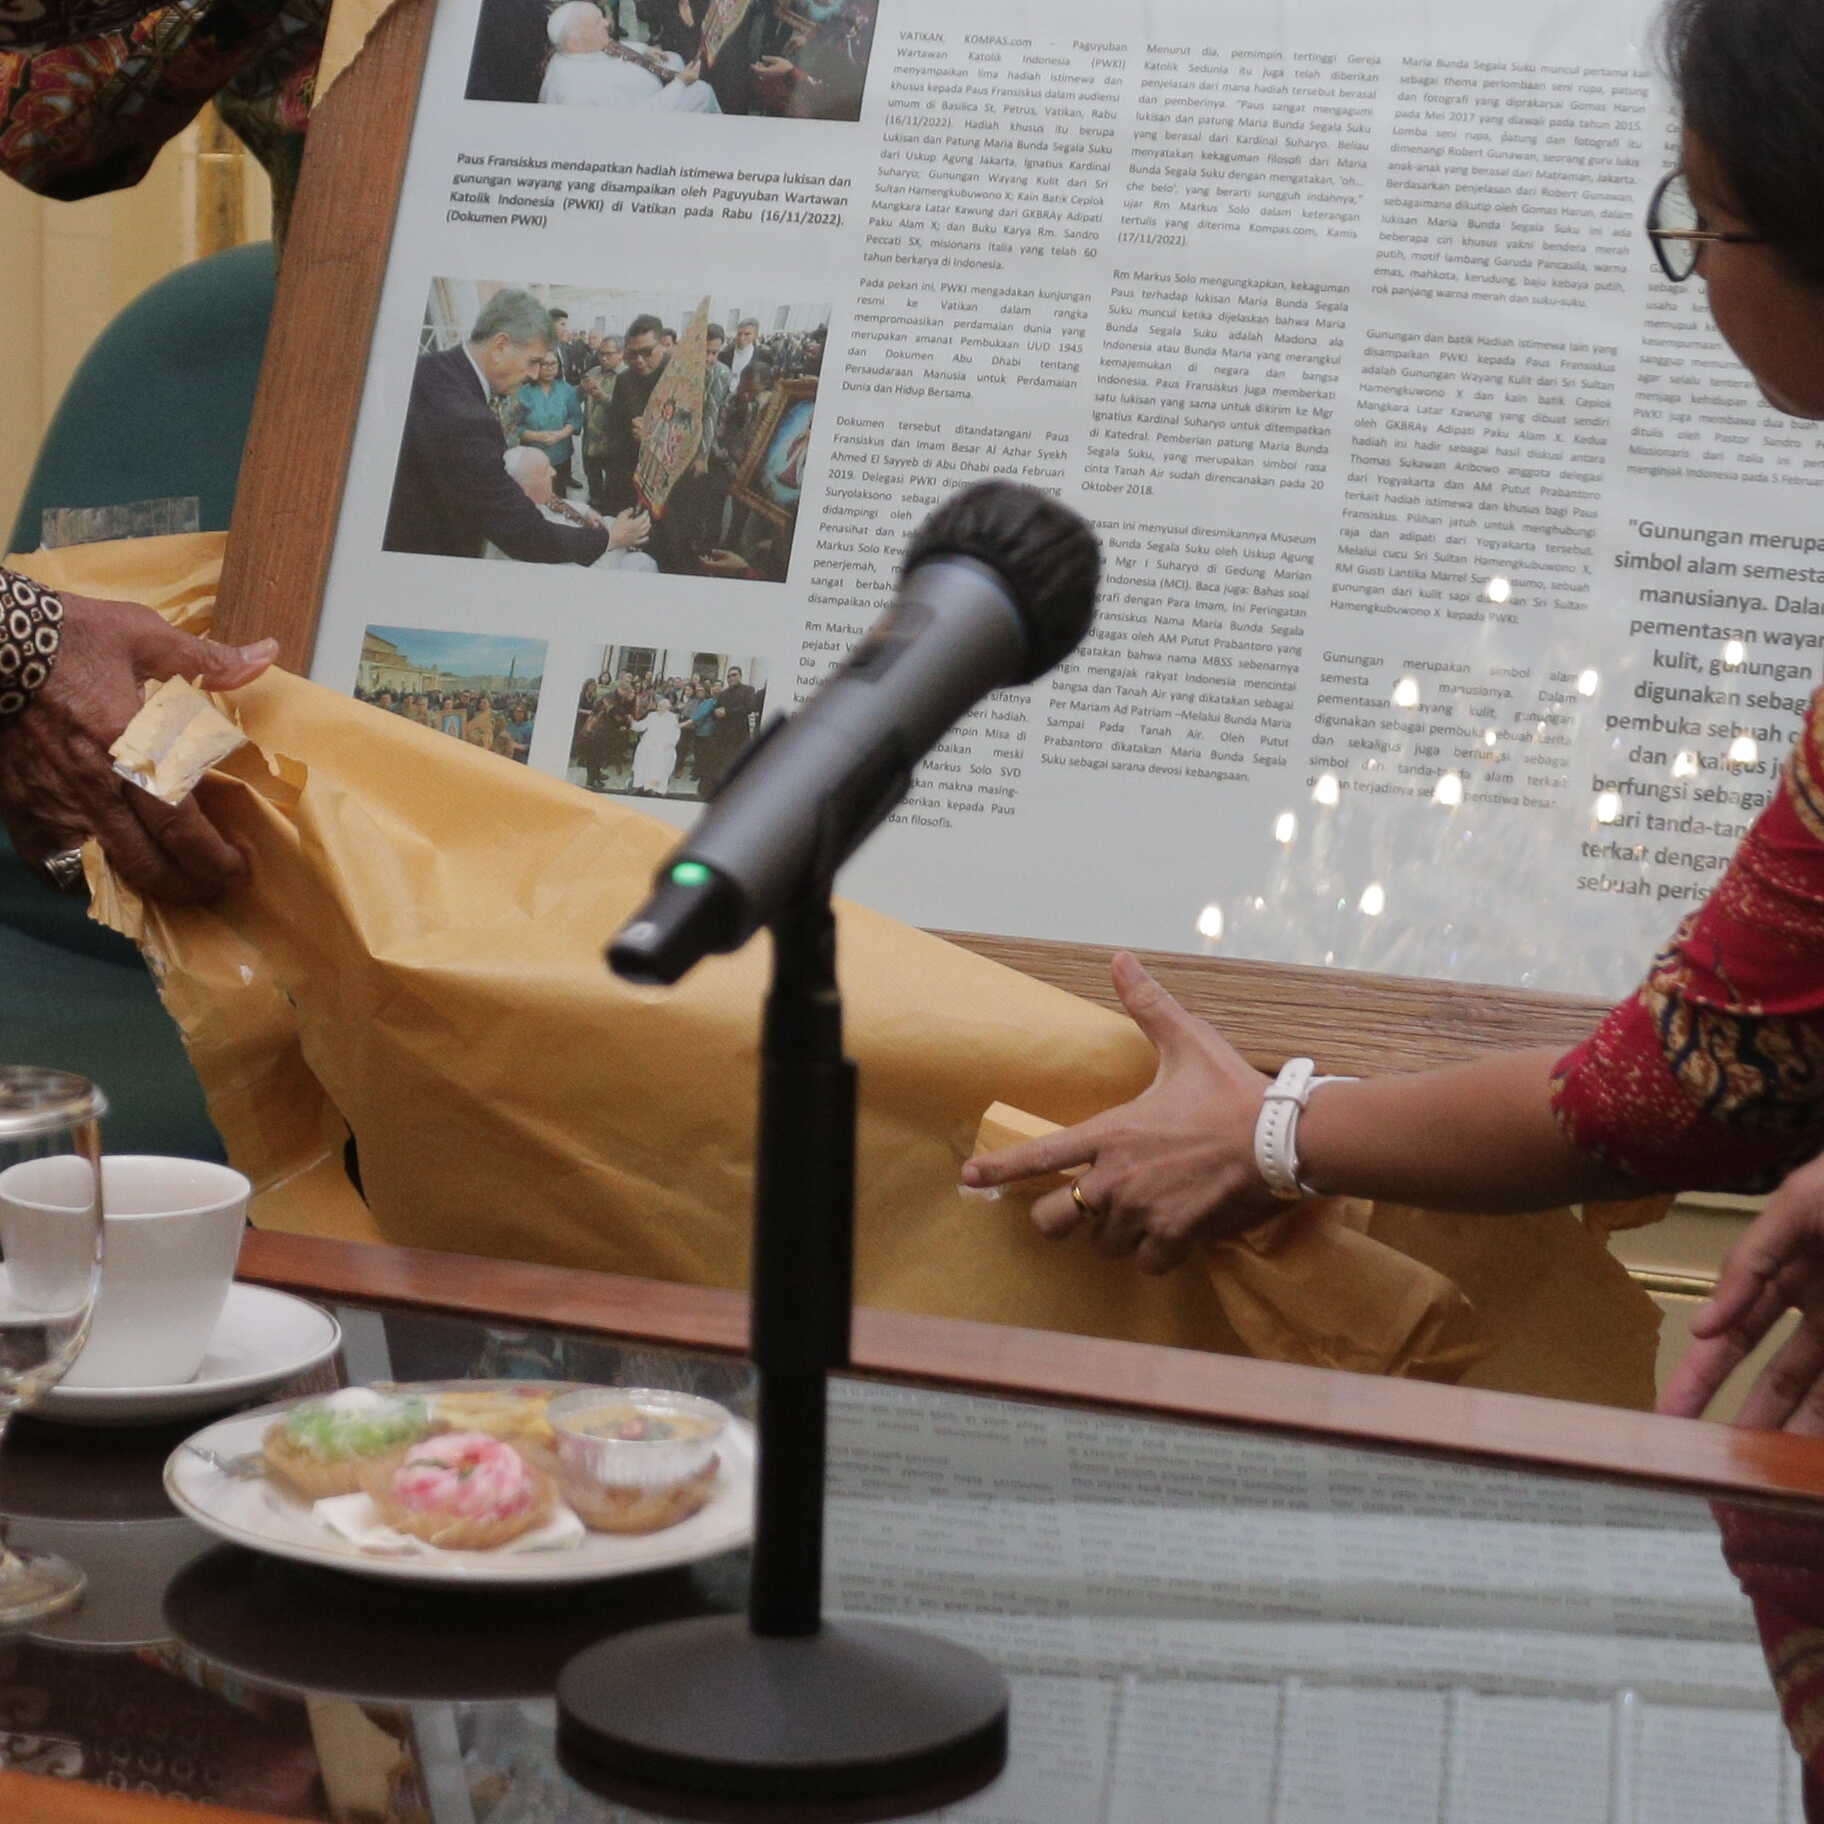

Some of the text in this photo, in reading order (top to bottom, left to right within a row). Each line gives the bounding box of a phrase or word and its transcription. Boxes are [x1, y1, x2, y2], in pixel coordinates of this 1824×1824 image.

[456, 152, 852, 188] Paus Fransiskus mendapatkan hadiah istimewa berupa lukisan dan
[452, 173, 849, 207] gunungan wayang yang disampaikan oleh Paguyuban Wartawan
[449, 191, 491, 205] Katolik
[497, 193, 556, 208] Indonesia
[562, 196, 605, 214] (PWKI)
[610, 200, 624, 213] di
[631, 201, 677, 217] Vatikan
[683, 205, 714, 219] pada
[721, 207, 753, 220] Rabu
[445, 209, 548, 230] (Dokumen PWKI)
[1613, 550, 1683, 573] simbol
[1686, 556, 1738, 577] alam
[1629, 619, 1758, 644] pementasan
[1633, 679, 1814, 716] digunakan sebag
[1605, 713, 1702, 736] pembuka
[1628, 745, 1668, 765] dan
[1591, 773, 1772, 810] berfungsi sebagai
[1599, 810, 1746, 838] ari tanda-tan
[1653, 846, 1728, 873] dengan
[1656, 881, 1711, 902] peris
